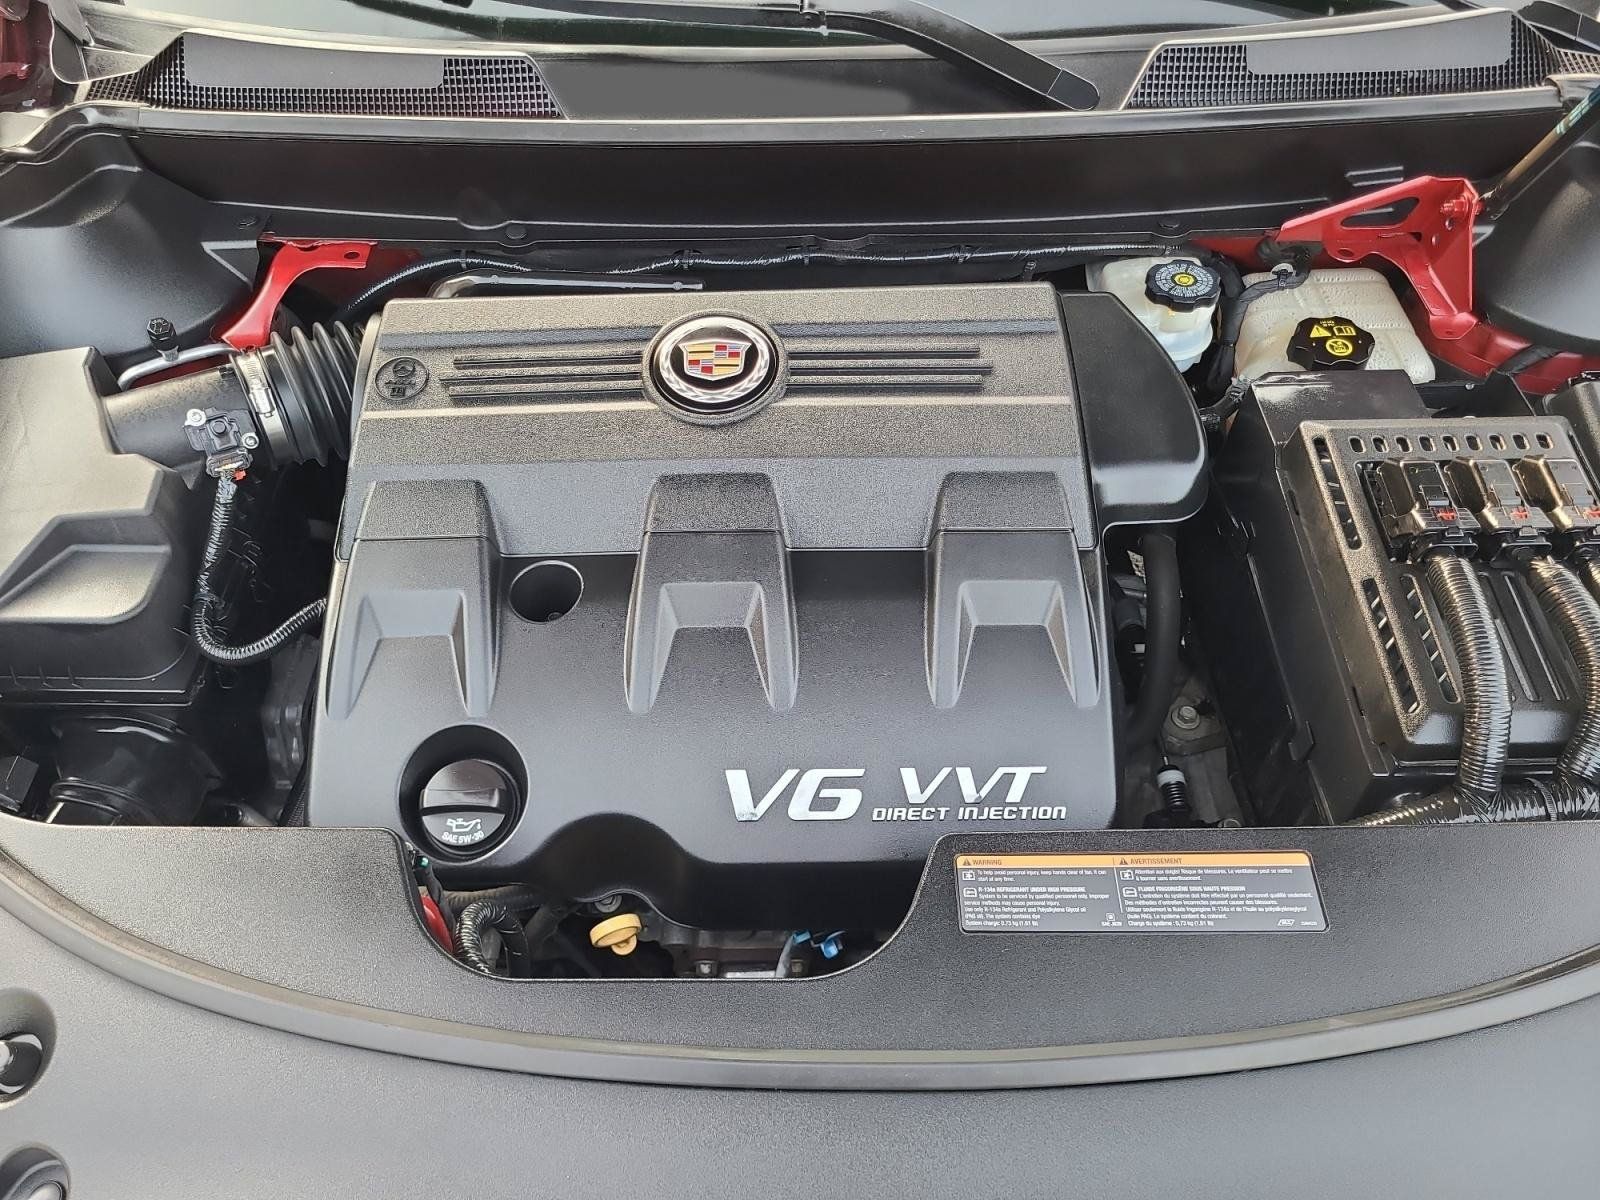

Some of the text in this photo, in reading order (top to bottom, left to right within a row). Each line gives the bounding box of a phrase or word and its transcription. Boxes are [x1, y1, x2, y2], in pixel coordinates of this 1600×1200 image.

[725, 768, 866, 822] V6
[899, 766, 1048, 804] VVT
[872, 806, 1067, 822] DIRECT INJECTION
[442, 832, 458, 843] SAE
